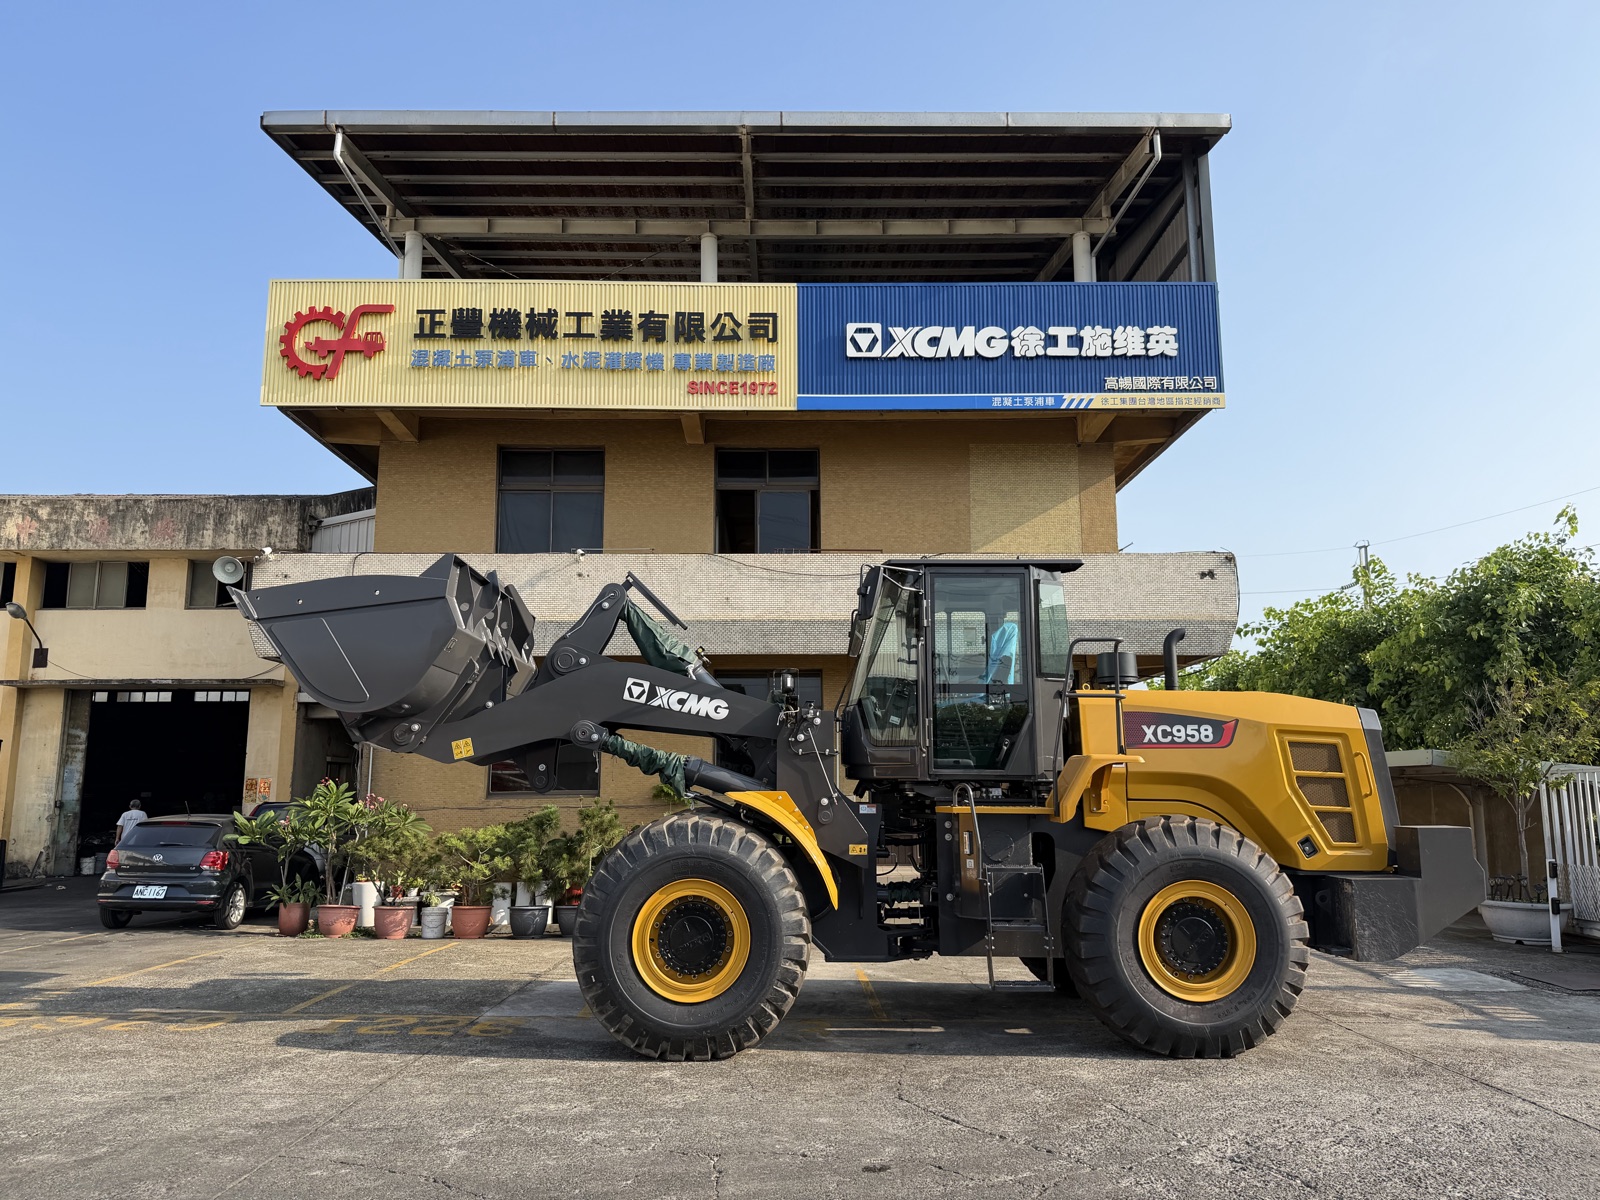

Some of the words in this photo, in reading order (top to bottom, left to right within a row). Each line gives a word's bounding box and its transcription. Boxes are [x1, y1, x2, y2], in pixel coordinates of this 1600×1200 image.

[413, 307, 778, 343] 正豐機械工業有限公司
[881, 325, 1009, 358] XCMG
[1011, 325, 1179, 358] 徐工施维英
[673, 352, 776, 372] 專業製造廠
[687, 380, 778, 396] SINCE1972
[1104, 376, 1217, 390] 高暢國際有限公司
[991, 396, 1056, 407] 混凝土泵浦車
[646, 685, 730, 721] XCMG
[1141, 724, 1214, 743] XC958
